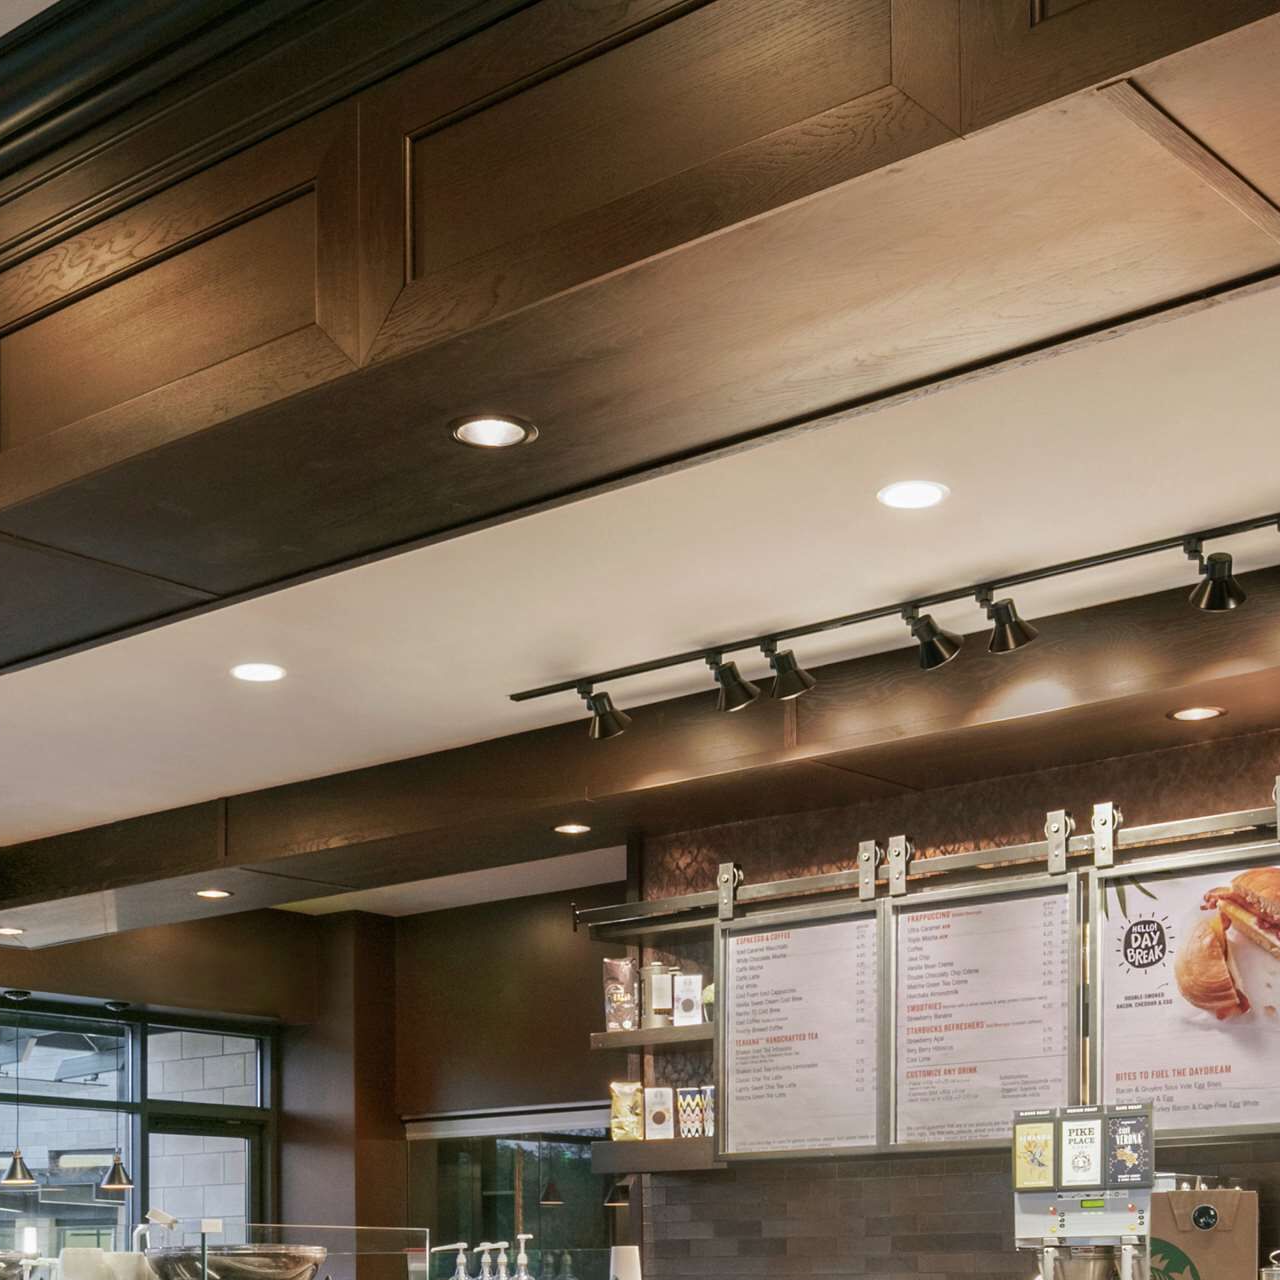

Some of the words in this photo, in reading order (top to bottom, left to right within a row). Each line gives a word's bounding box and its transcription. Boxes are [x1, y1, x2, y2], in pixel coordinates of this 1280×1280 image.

[1132, 923, 1157, 932] HELLO!
[1131, 931, 1160, 948] DAY
[1127, 945, 1163, 966] BREAK
[1116, 1072, 1137, 1081] BITES
[1140, 1071, 1148, 1079] TO
[1152, 1070, 1169, 1079] FUEL
[1173, 1068, 1185, 1077] THE
[1189, 1065, 1232, 1076] DAYDREAM
[1068, 1127, 1095, 1137] PIKE
[1068, 1137, 1095, 1145] PLACE
